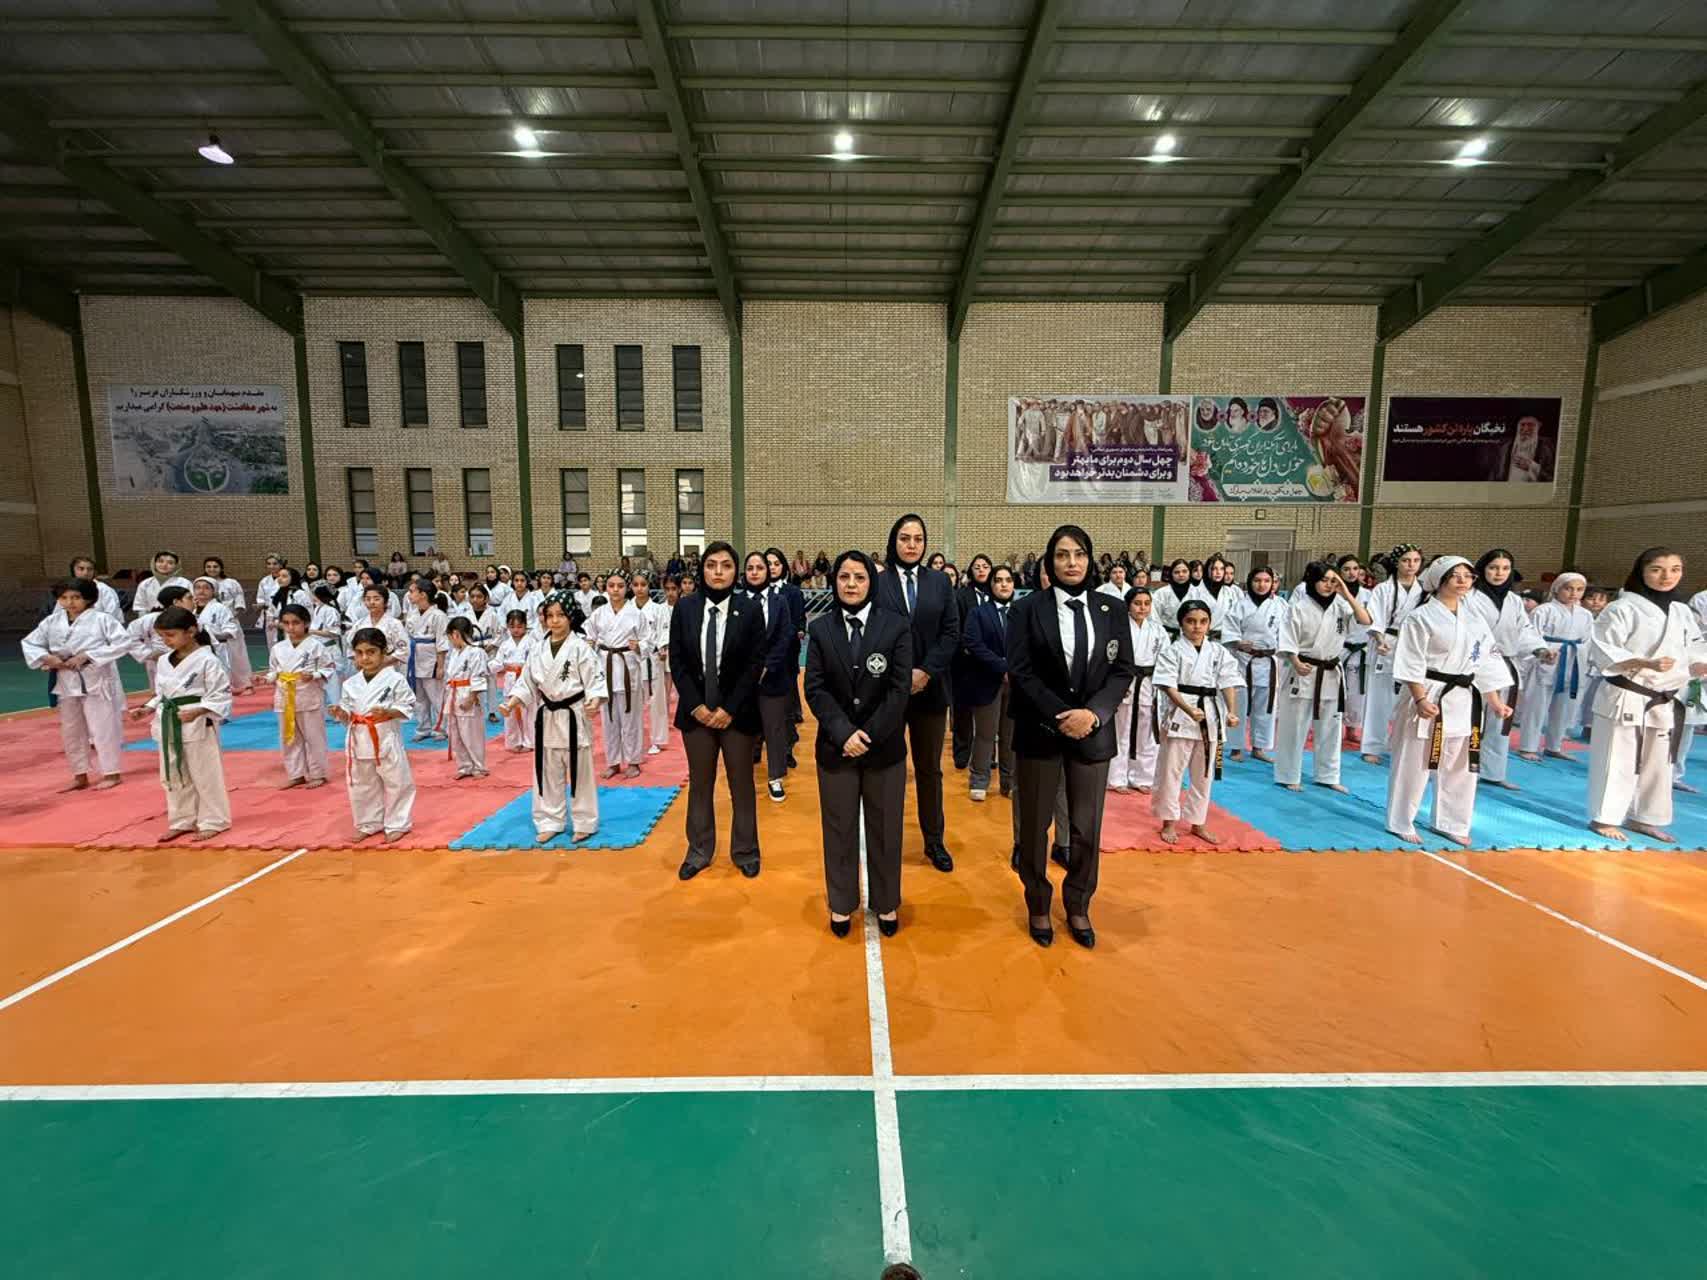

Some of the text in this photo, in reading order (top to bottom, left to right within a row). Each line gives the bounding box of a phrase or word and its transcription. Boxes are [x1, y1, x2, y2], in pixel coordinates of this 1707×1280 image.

[1393, 423, 1424, 433] هستند
[1423, 422, 1448, 437] کشور
[1473, 421, 1505, 437] نخبگان
[1071, 454, 1173, 468] چهل سال دوم برای ما بهتر
[1277, 457, 1305, 476] خون
[1054, 467, 1173, 480] و برای دشمنان بدتر خواهد بود
